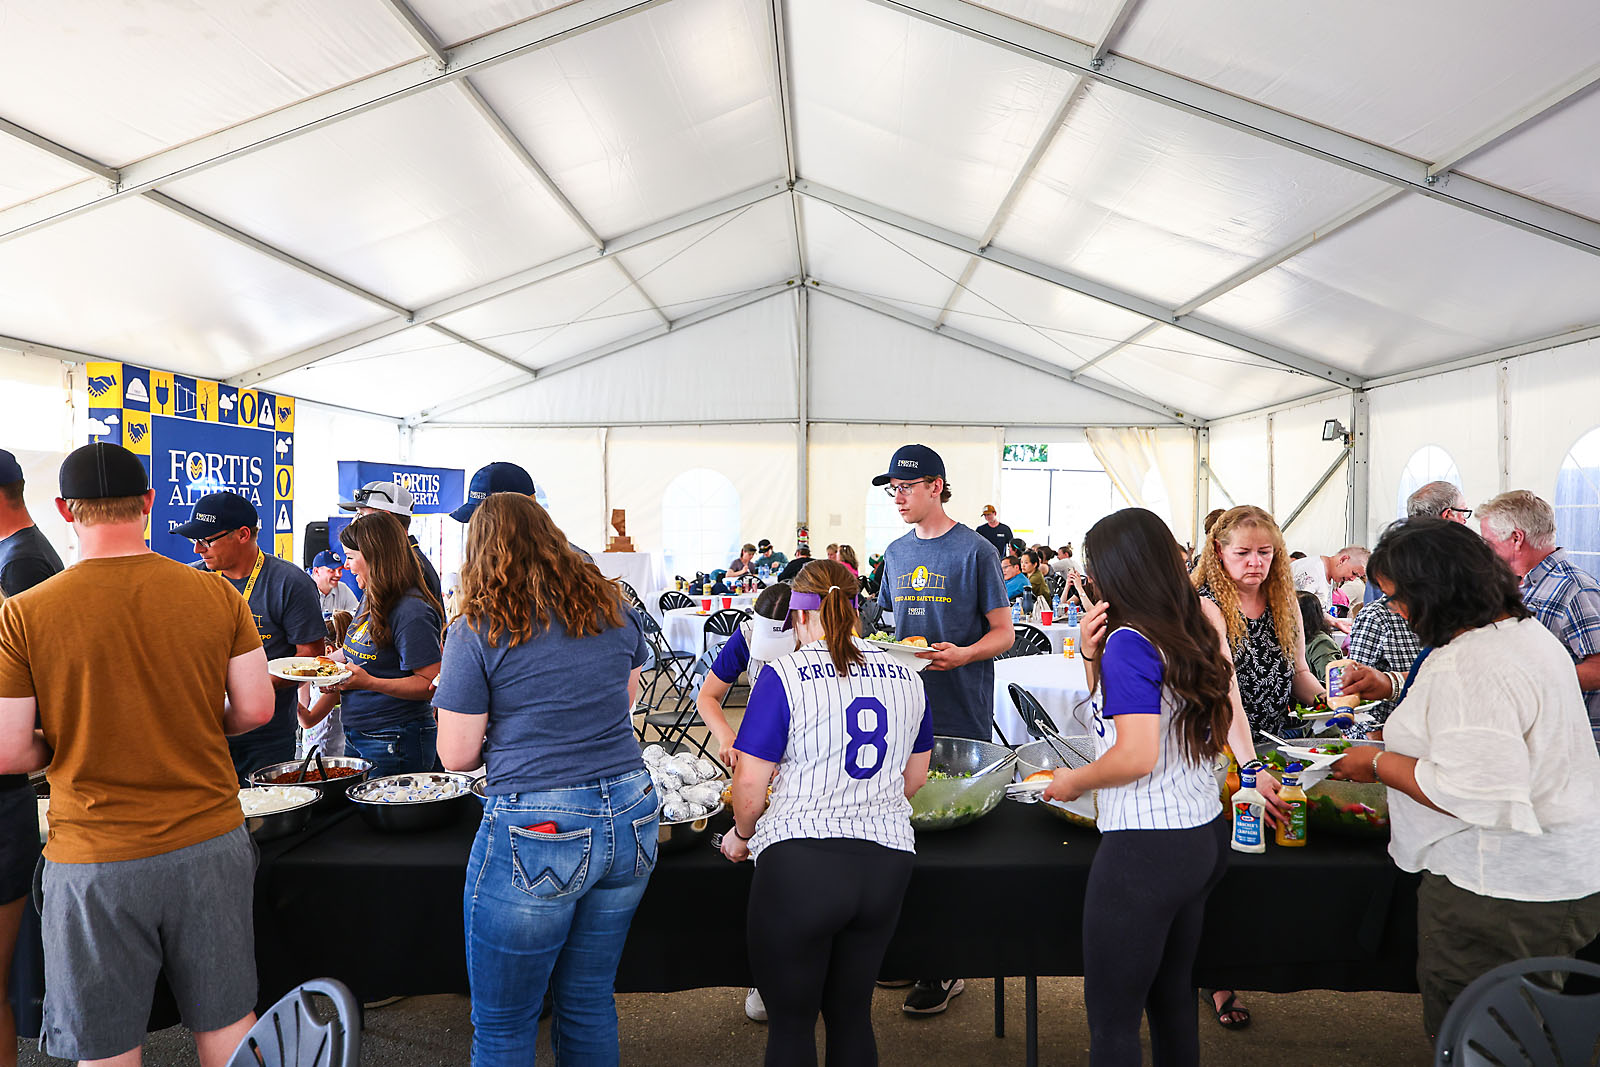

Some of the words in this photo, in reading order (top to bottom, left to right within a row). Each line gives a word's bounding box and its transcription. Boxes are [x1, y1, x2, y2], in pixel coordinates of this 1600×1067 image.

[168, 449, 263, 486] FORTIS
[392, 472, 440, 493] FORTIS
[168, 484, 263, 506] ALTA
[410, 492, 440, 505] ERTA
[359, 652, 377, 661] EXPO
[797, 662, 912, 683] KROCHINSKI
[845, 697, 889, 780] 8
